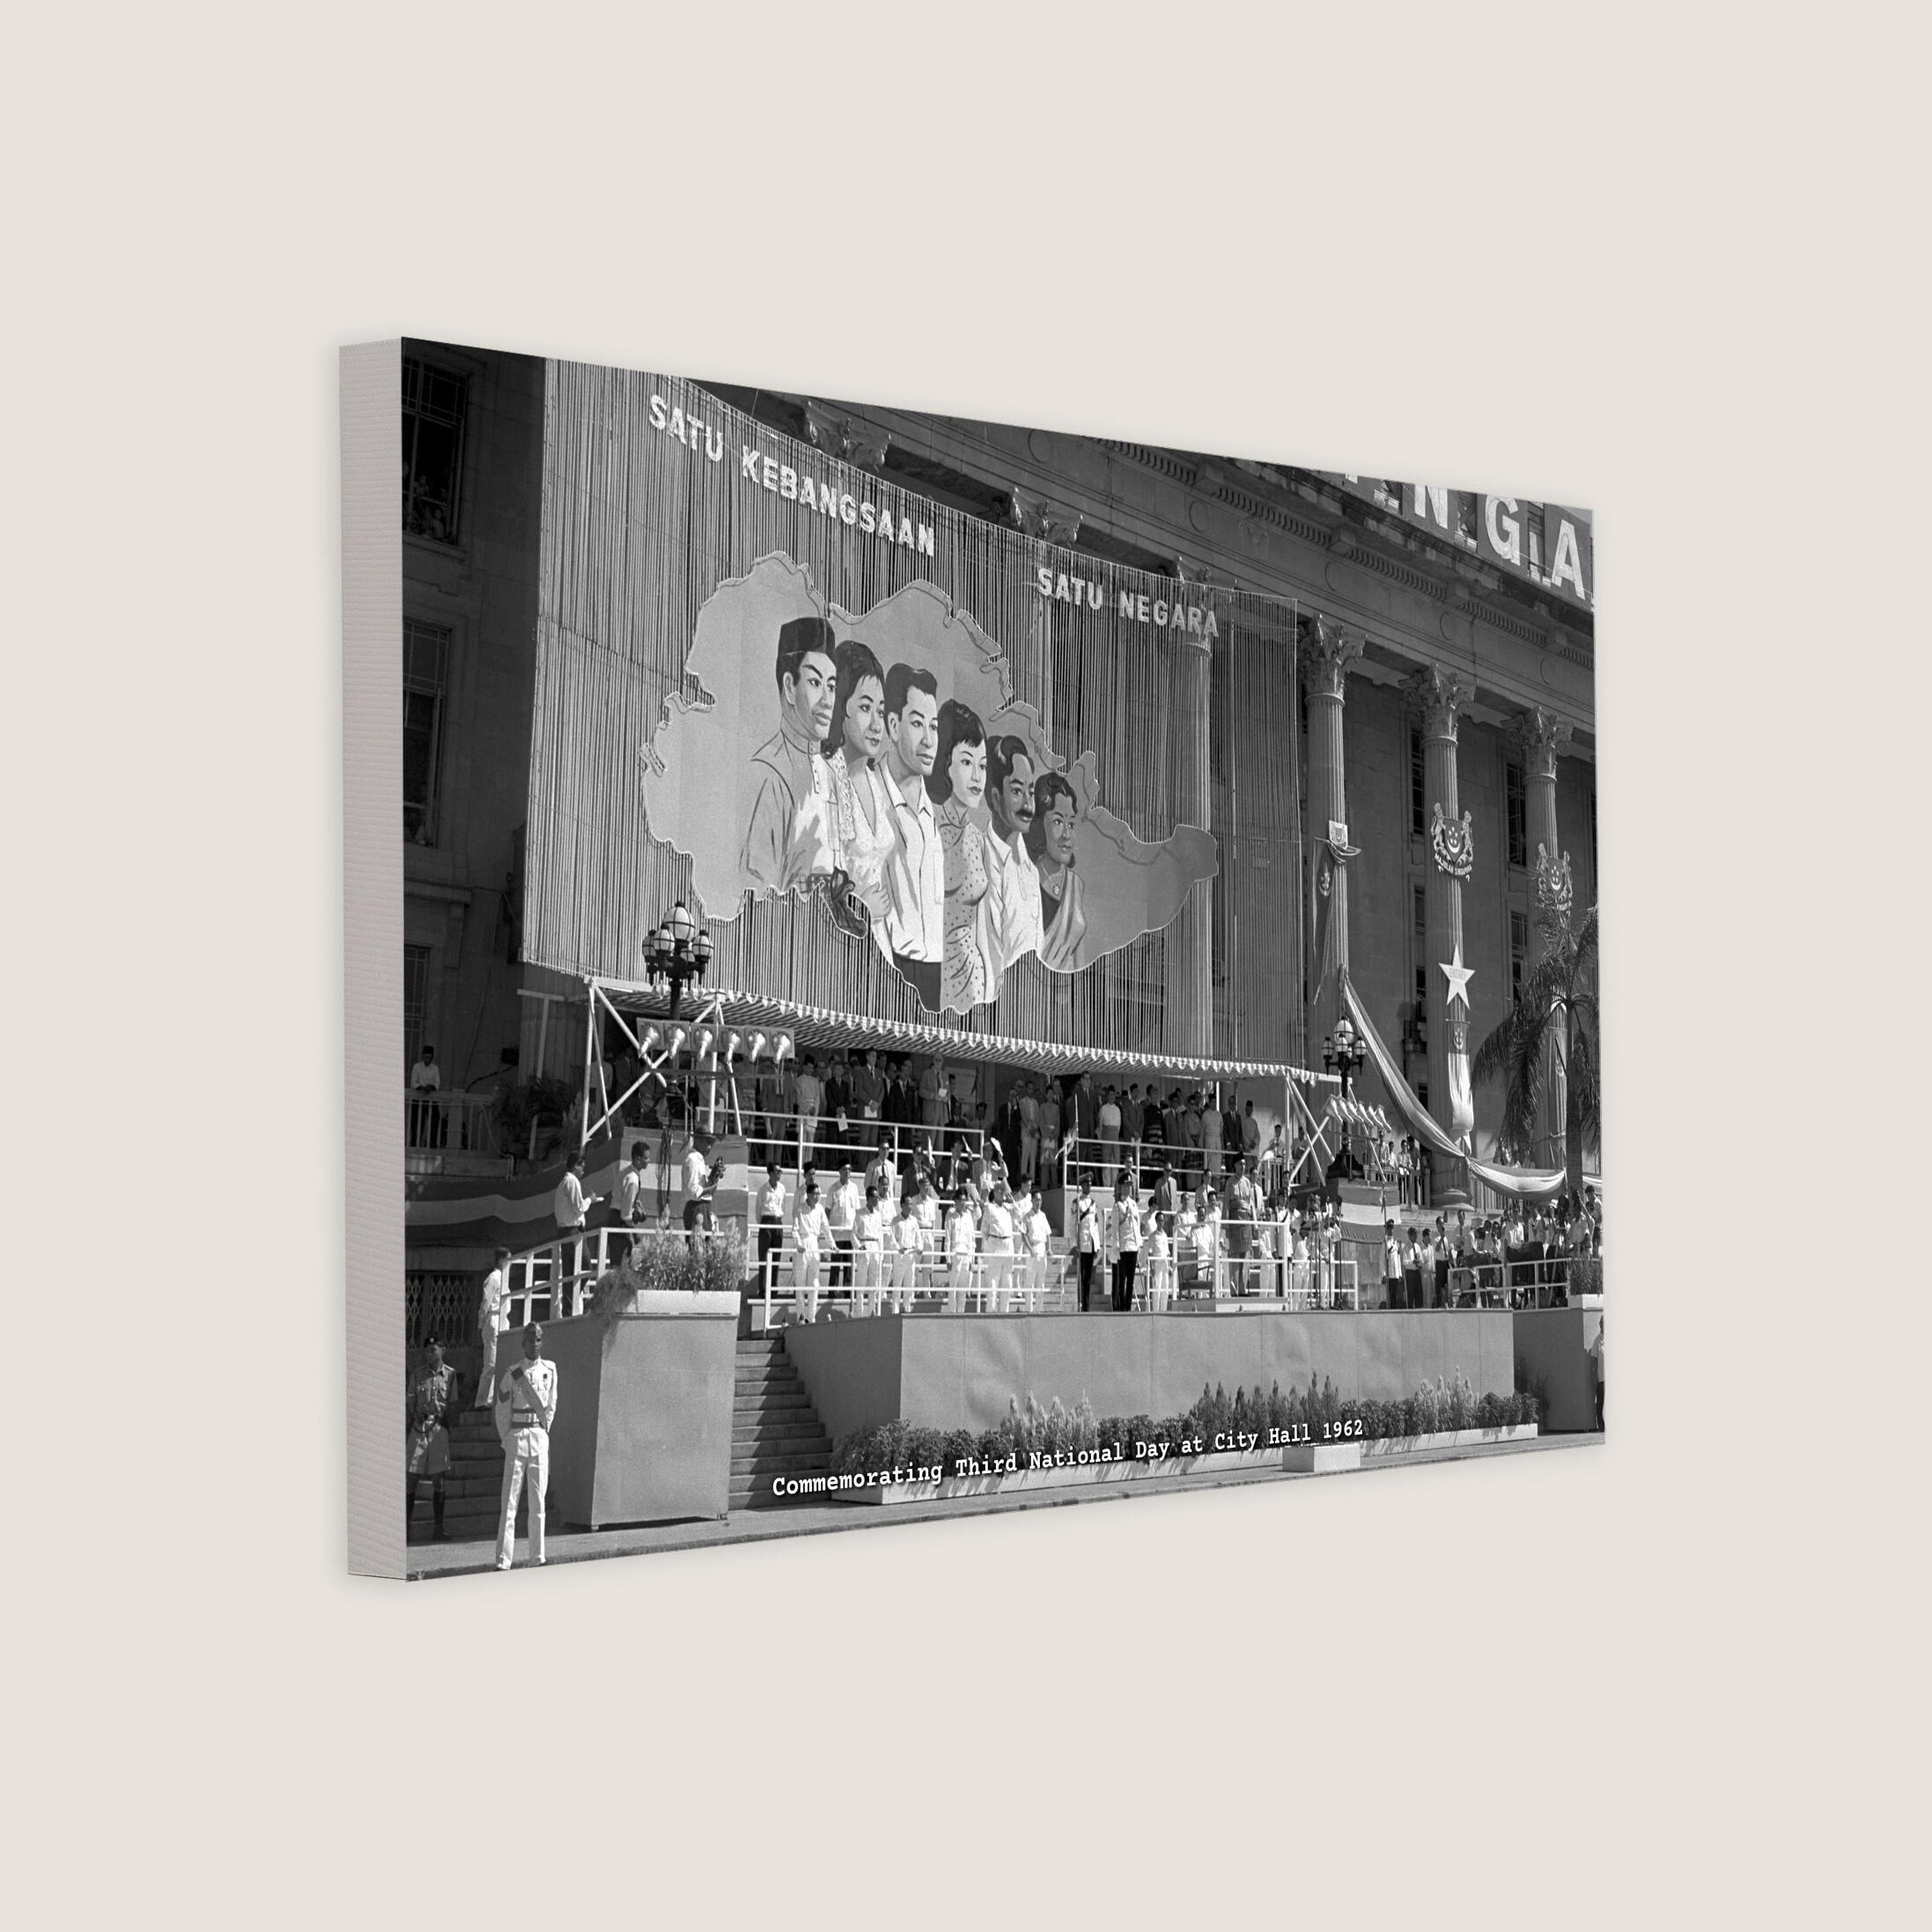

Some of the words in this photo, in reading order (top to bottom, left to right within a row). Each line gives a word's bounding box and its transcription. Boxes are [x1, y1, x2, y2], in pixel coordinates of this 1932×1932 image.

[649, 395, 723, 462] SATU
[742, 446, 934, 557] KEBANGSAAN
[1038, 568, 1102, 610] SATU
[1119, 590, 1219, 638] NEGARA
